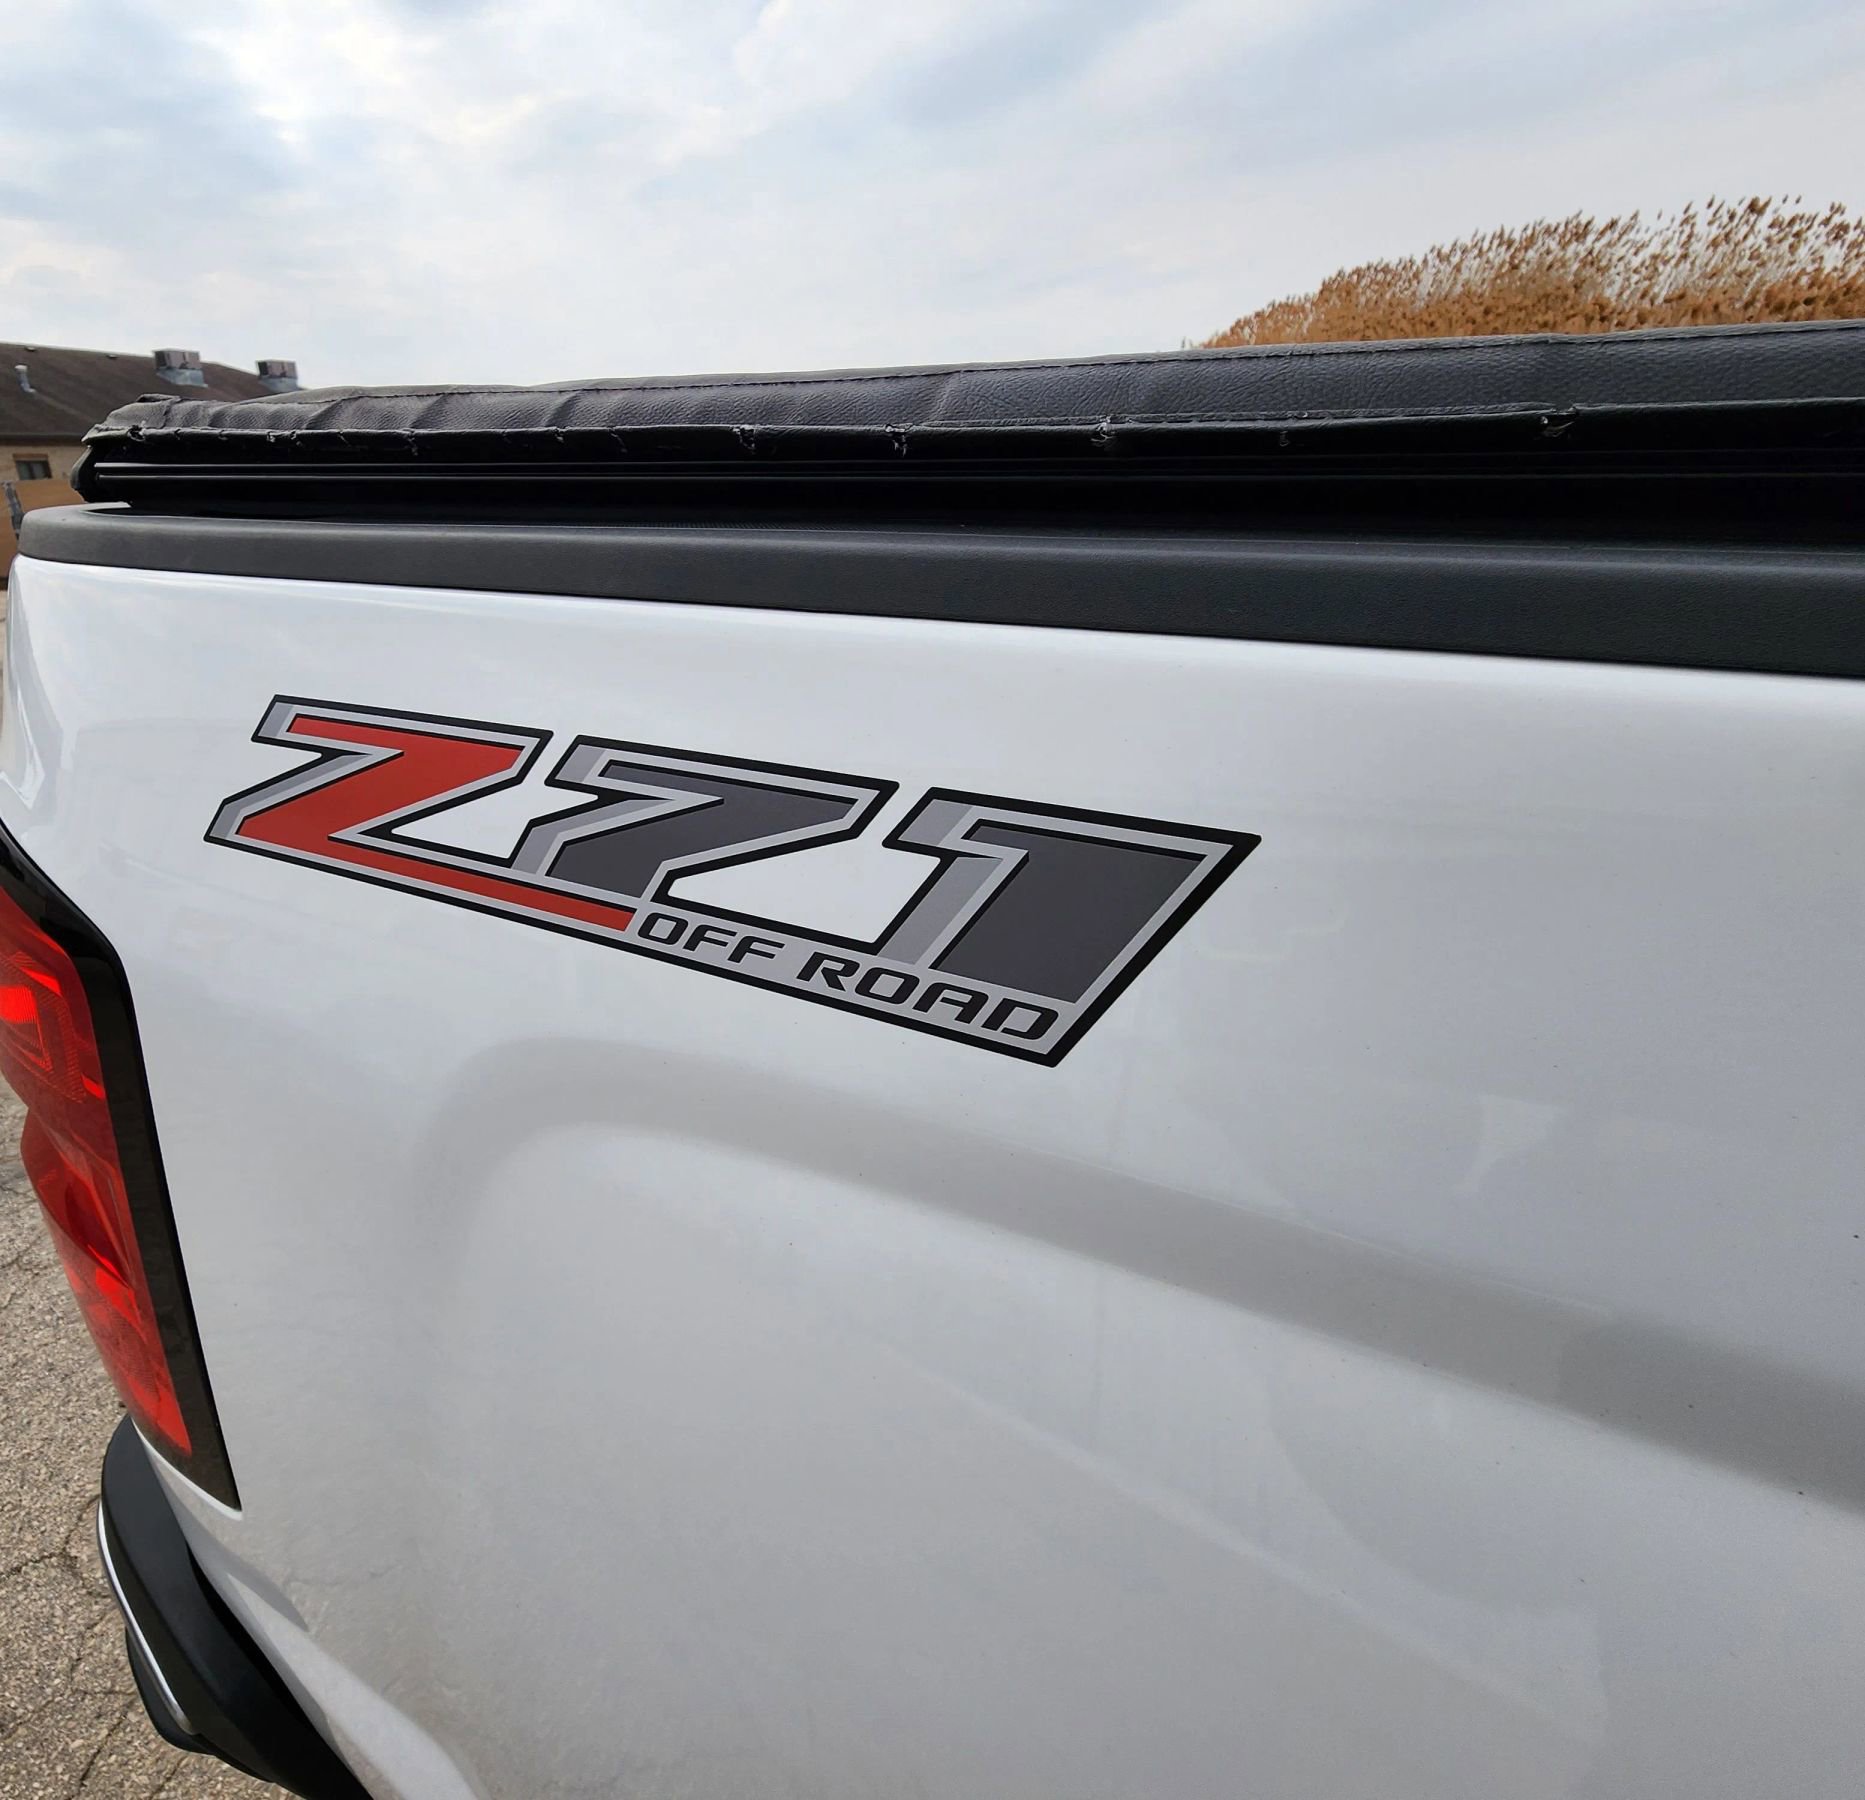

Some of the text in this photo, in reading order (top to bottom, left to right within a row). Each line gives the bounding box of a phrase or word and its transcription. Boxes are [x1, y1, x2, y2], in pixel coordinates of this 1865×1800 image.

[205, 694, 1260, 1020] Z71
[637, 912, 1059, 1040] OFF ROAD
